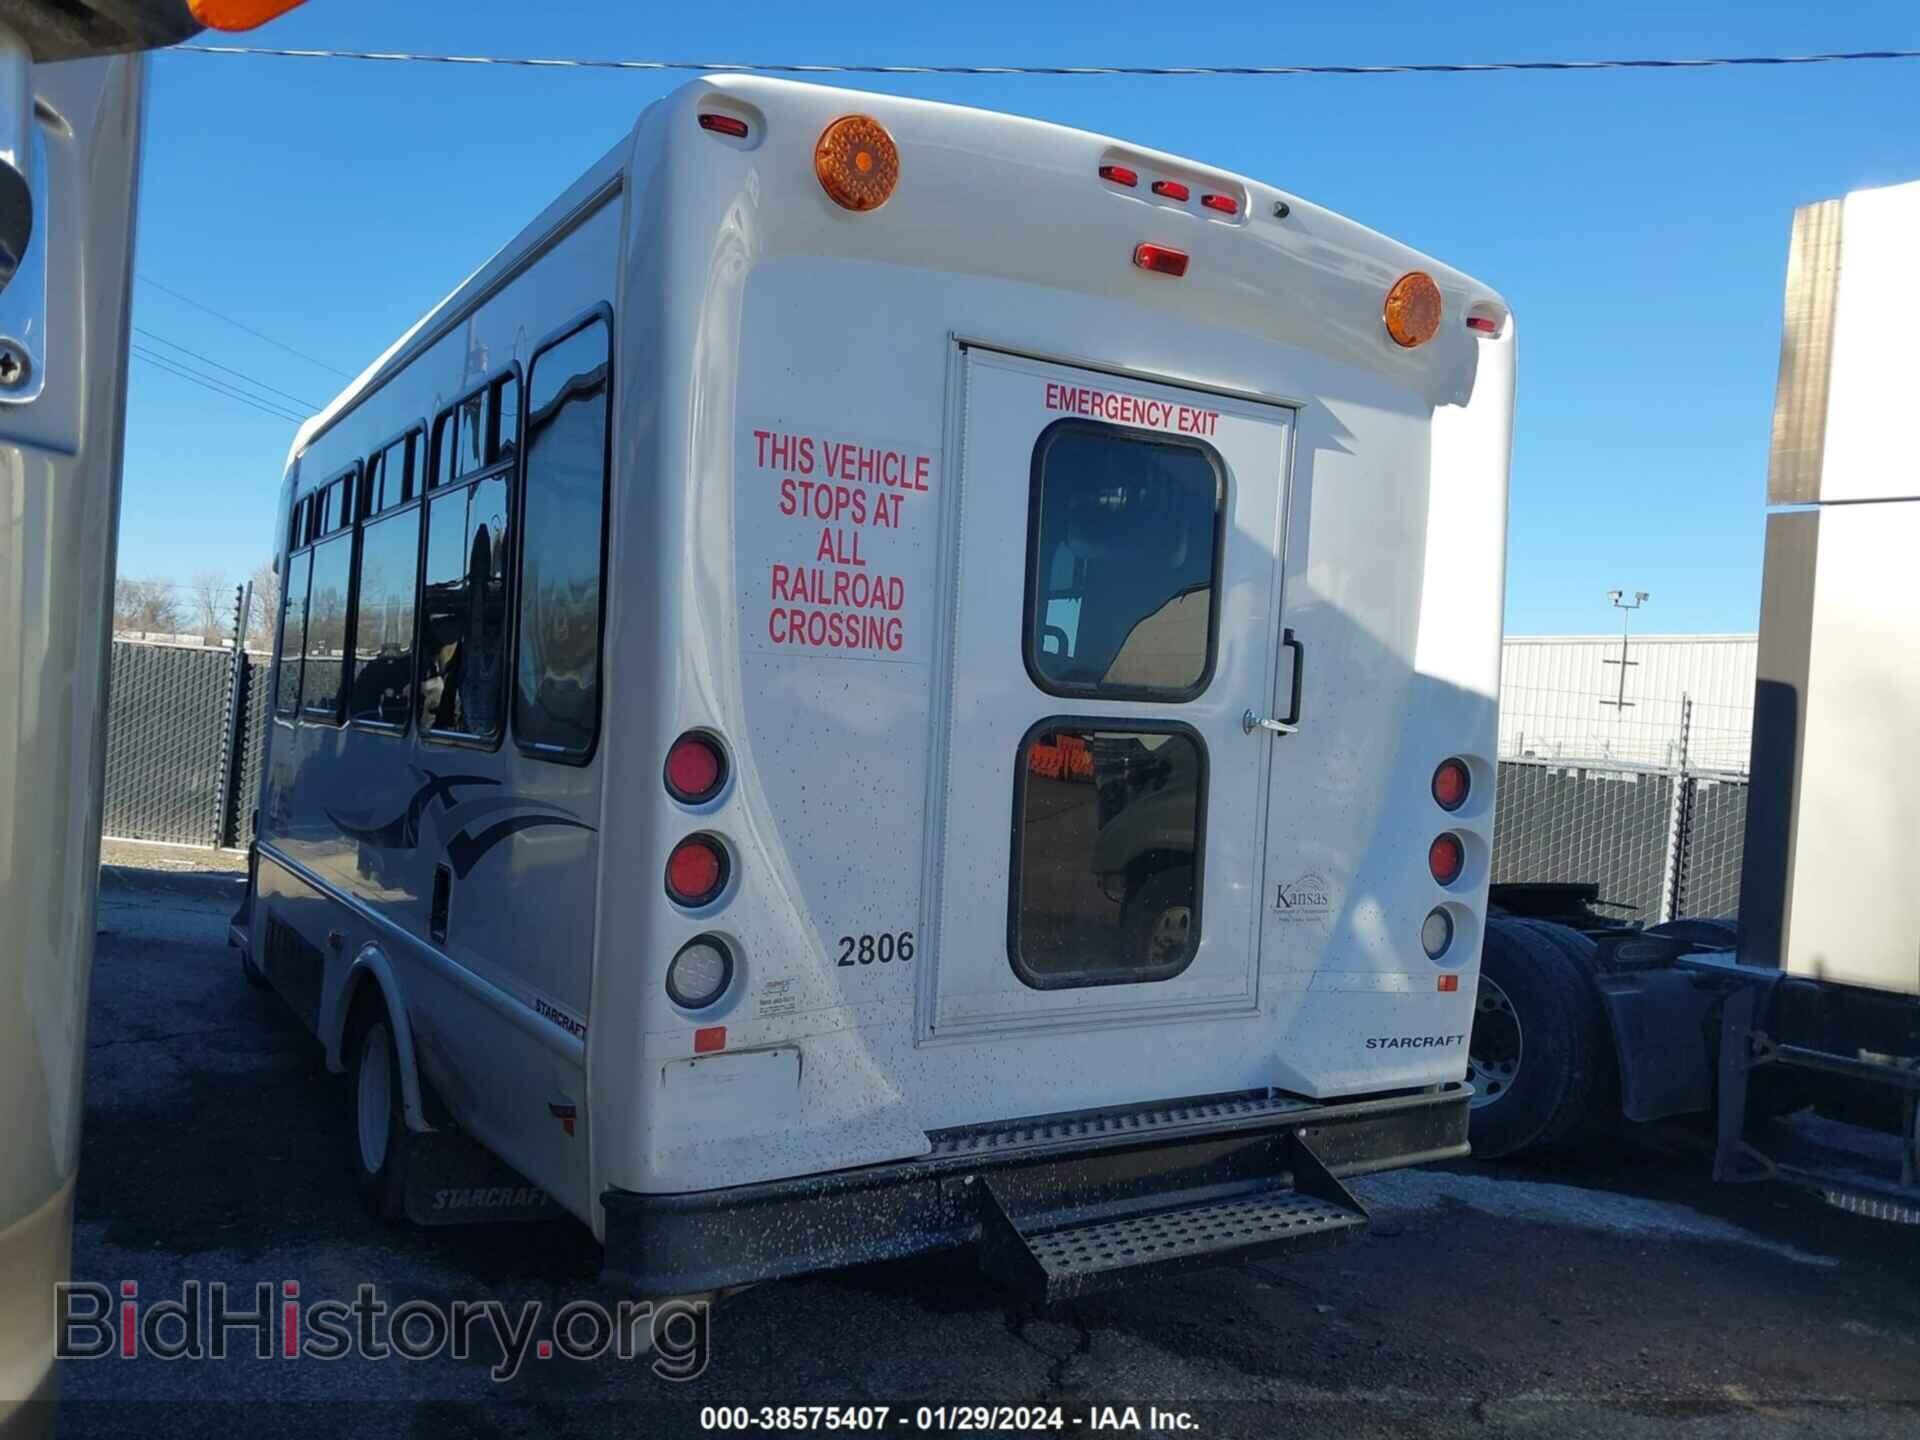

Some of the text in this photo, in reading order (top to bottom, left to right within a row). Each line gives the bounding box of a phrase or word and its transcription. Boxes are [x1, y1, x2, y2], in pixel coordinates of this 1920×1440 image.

[1045, 383, 1220, 436] EMERGENCY EXIT
[753, 430, 930, 491] THIS VEHICLE
[779, 478, 905, 529] STOPS AT
[816, 527, 867, 566] ALL
[771, 564, 905, 612] RAILROAD
[768, 607, 904, 652] CROSSING
[1276, 884, 1328, 908] Kansas
[837, 931, 915, 968] 2806
[535, 999, 587, 1040] STARCRAFT
[1366, 1035, 1465, 1049] STARCRAFT
[432, 1186, 548, 1210] STARCRAFT
